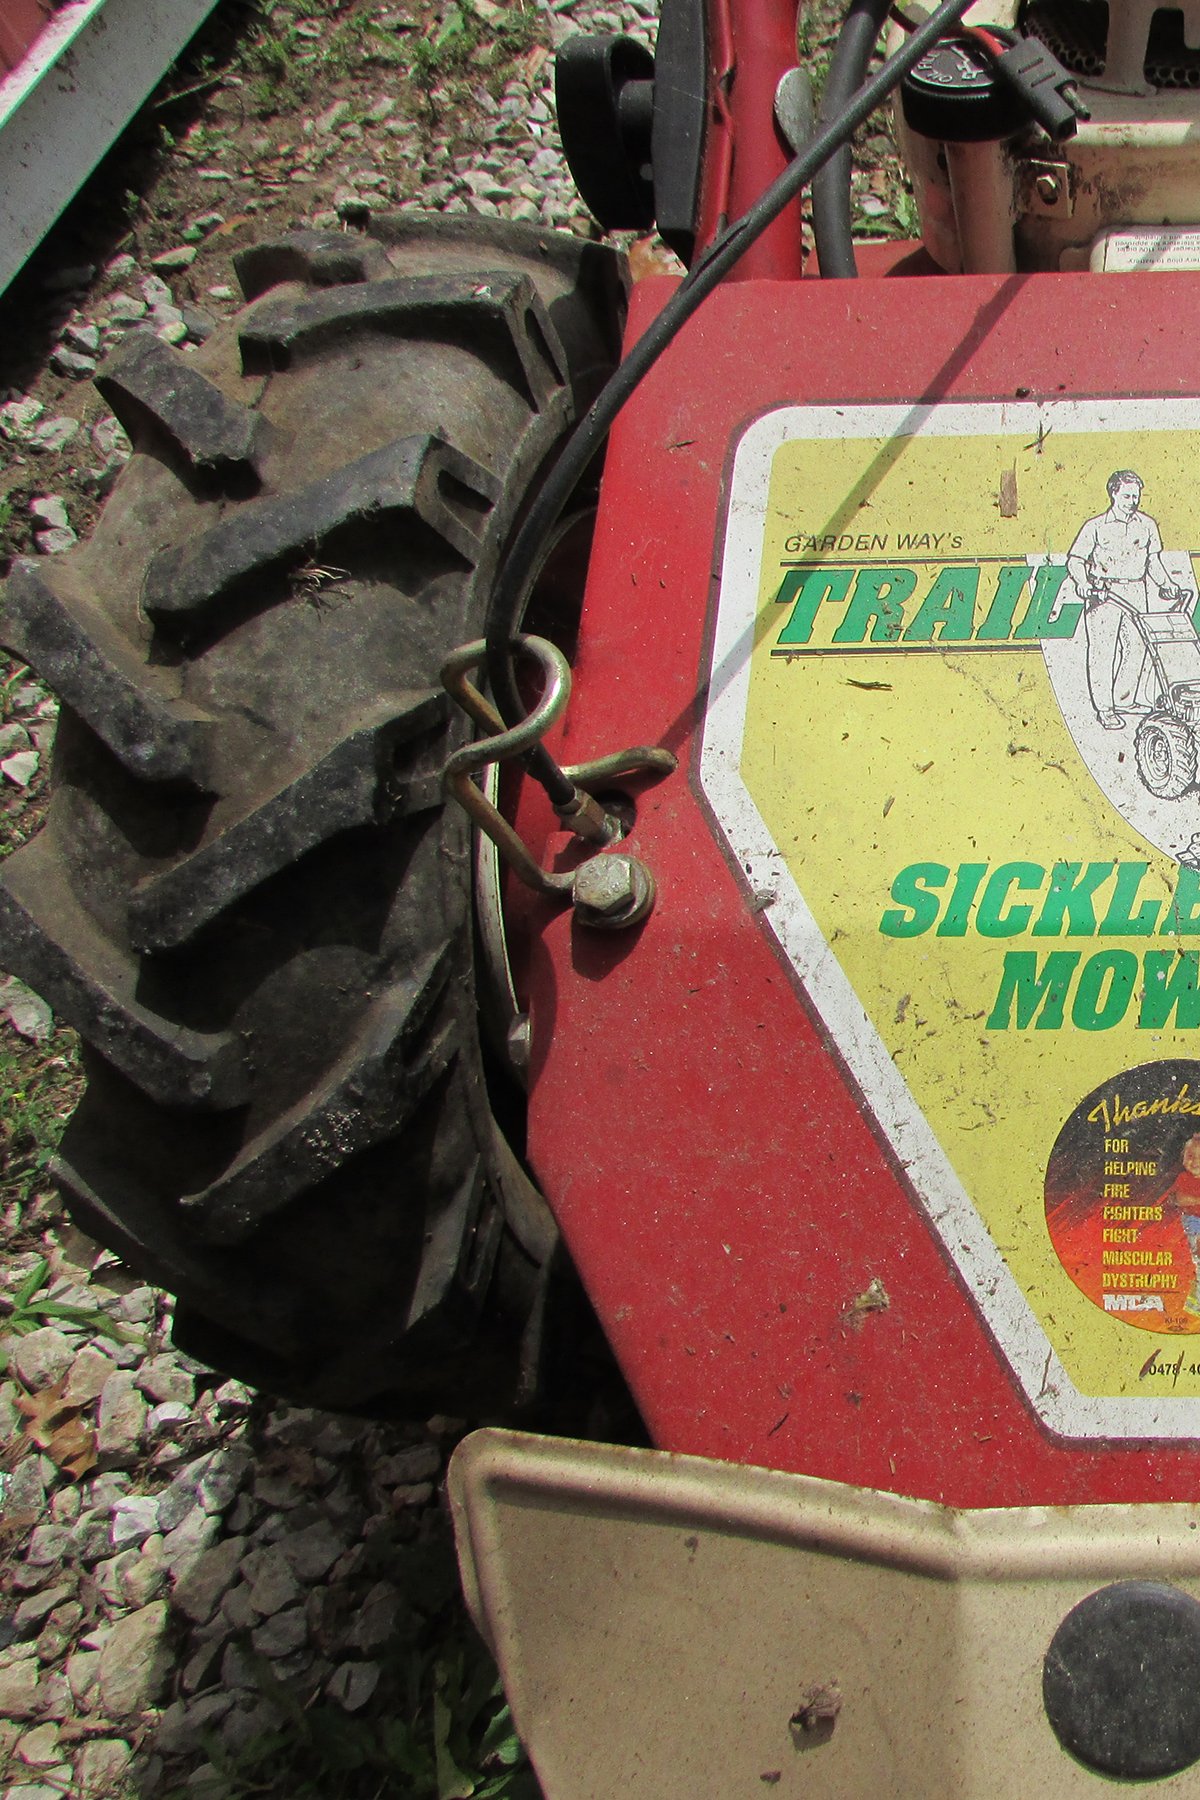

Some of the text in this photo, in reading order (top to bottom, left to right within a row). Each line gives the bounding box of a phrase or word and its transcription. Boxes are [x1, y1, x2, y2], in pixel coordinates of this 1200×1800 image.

[784, 532, 963, 553] GARDEN WAY's
[775, 565, 1085, 645] TRAIL
[1104, 1139, 1129, 1154] FOR
[1104, 1161, 1157, 1176] HELPING
[1103, 1183, 1131, 1198] FIRE
[1103, 1206, 1163, 1221] FIGHTERS
[1102, 1228, 1139, 1243] FIGHT
[1102, 1250, 1173, 1266] MUSCULAR
[1102, 1272, 1179, 1289] DYSTROPHY
